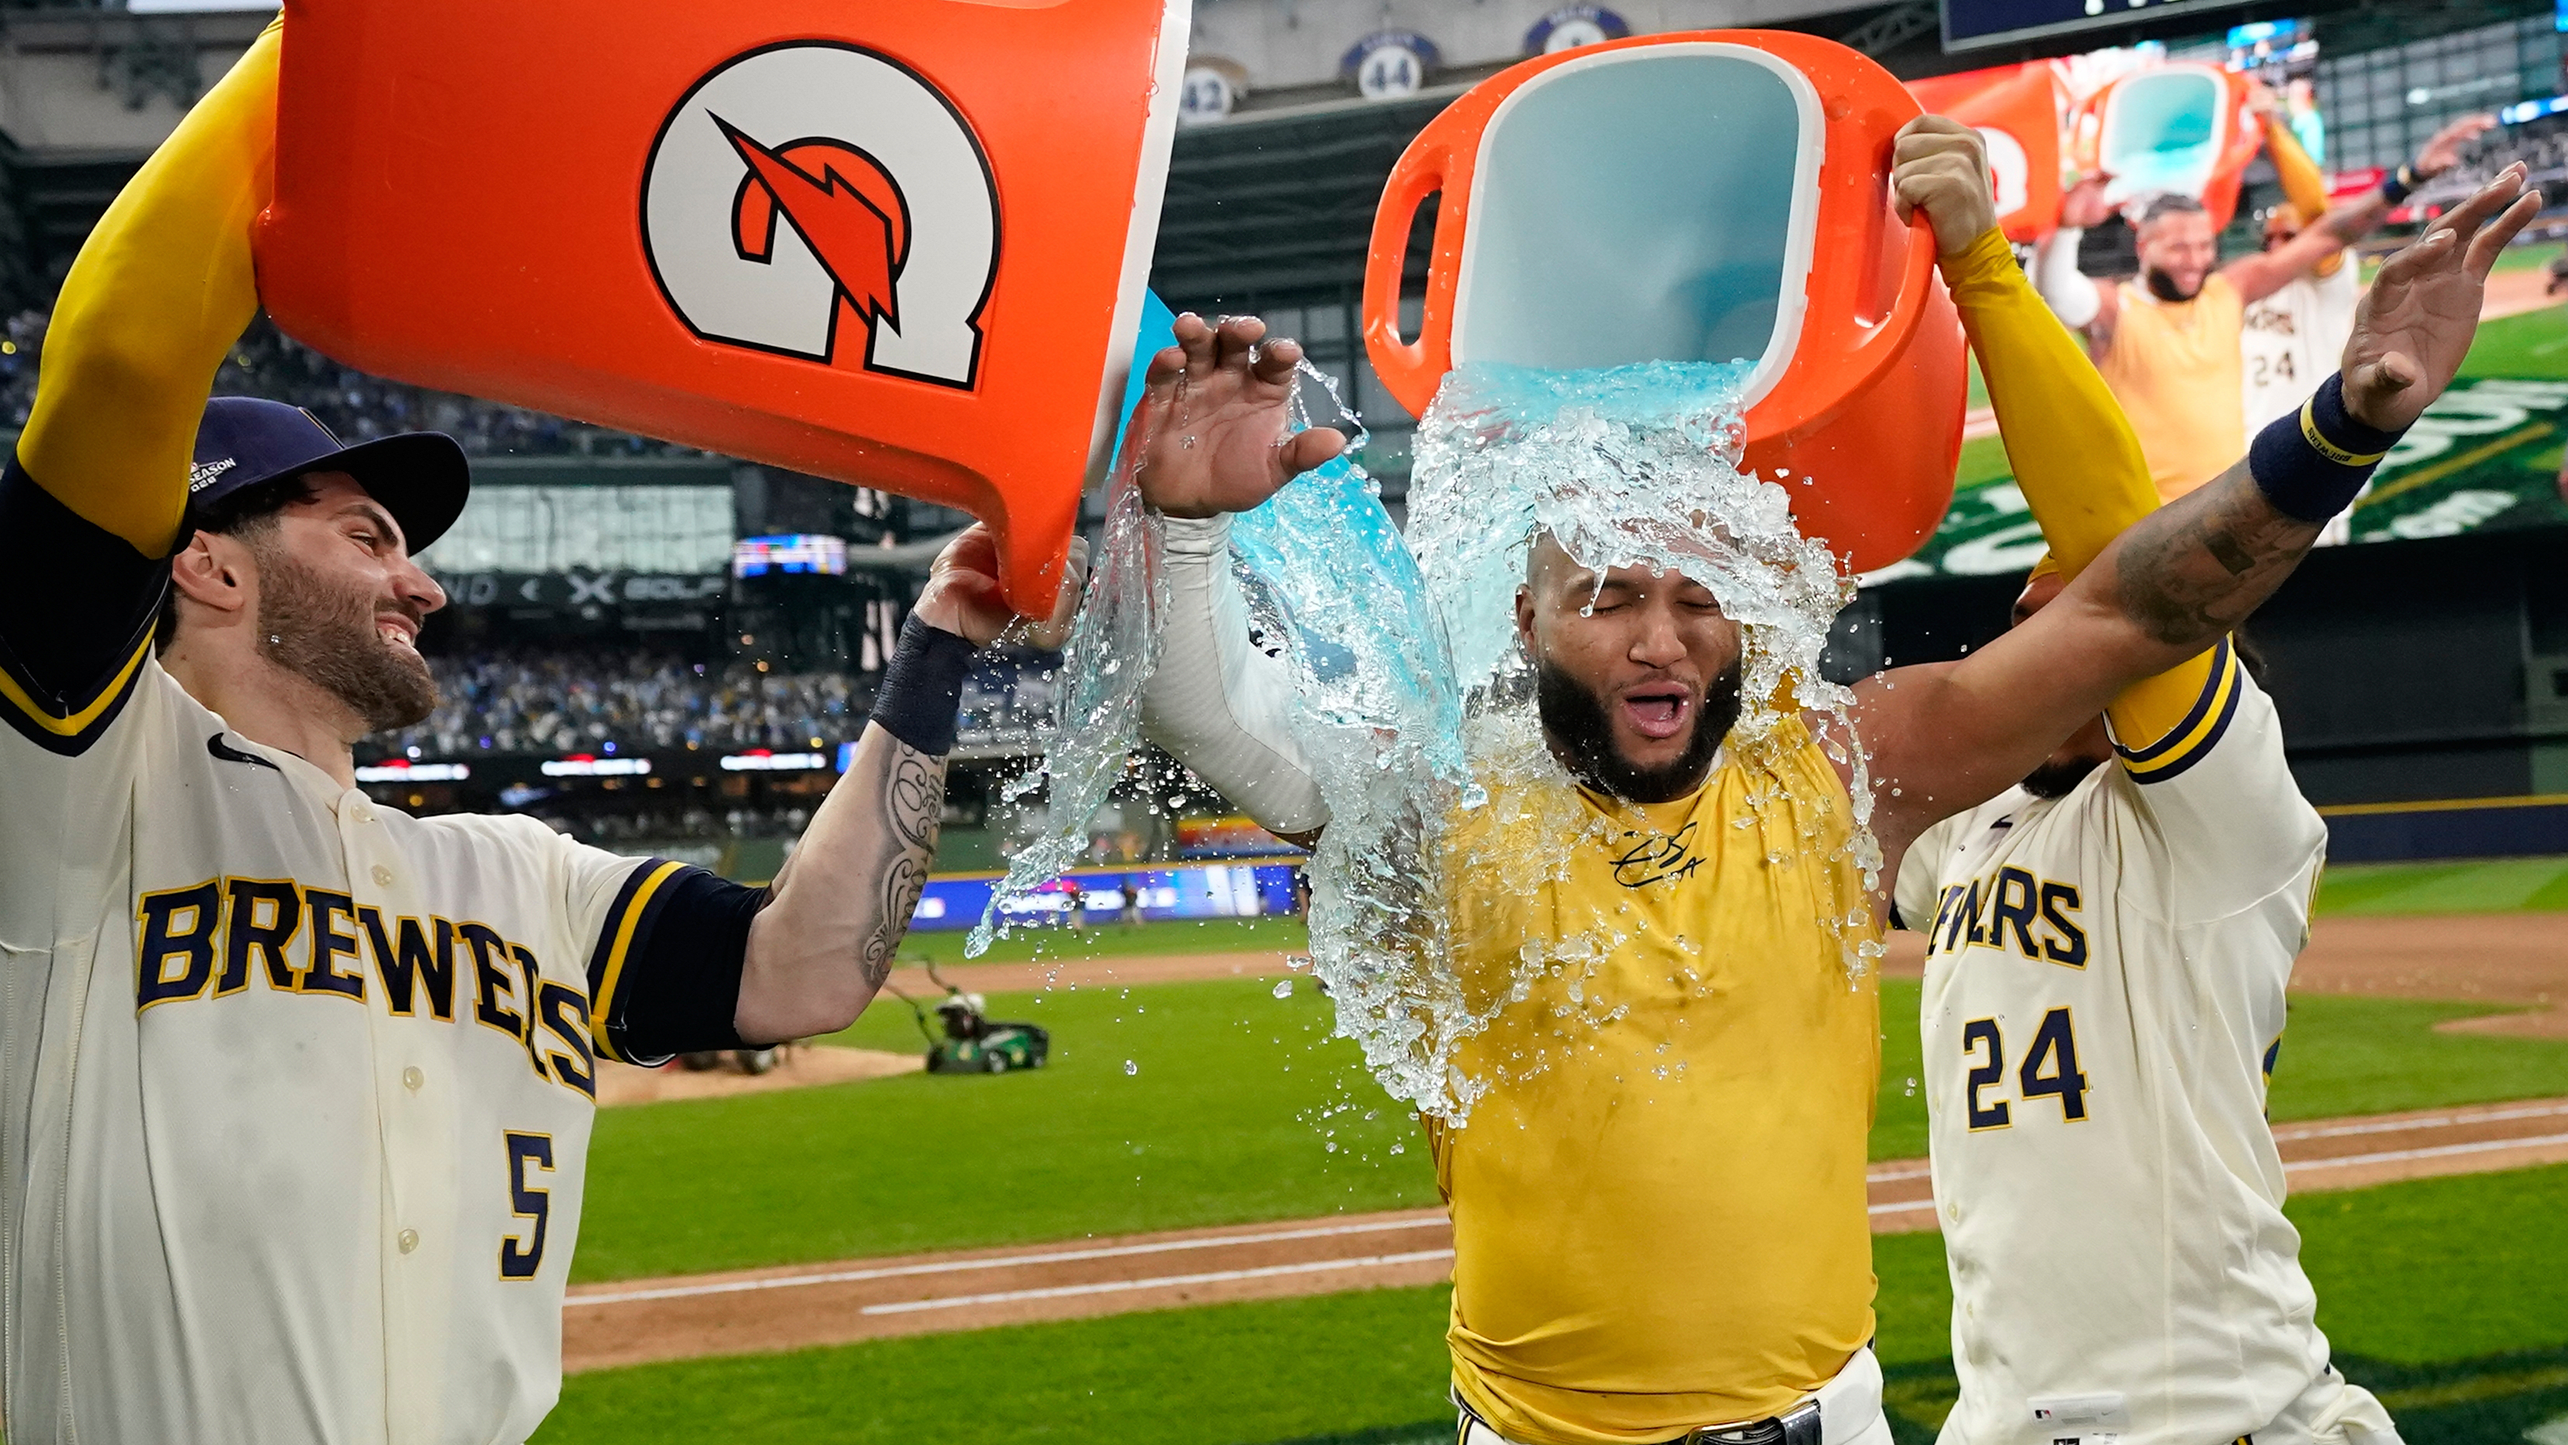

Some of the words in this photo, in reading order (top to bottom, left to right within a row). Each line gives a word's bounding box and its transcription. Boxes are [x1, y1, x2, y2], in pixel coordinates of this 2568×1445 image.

[1368, 58, 1411, 92] 44
[2252, 350, 2296, 388] 24
[136, 874, 597, 1106] BREWERS
[1964, 1005, 2089, 1133] 24
[498, 1128, 556, 1282] 5
